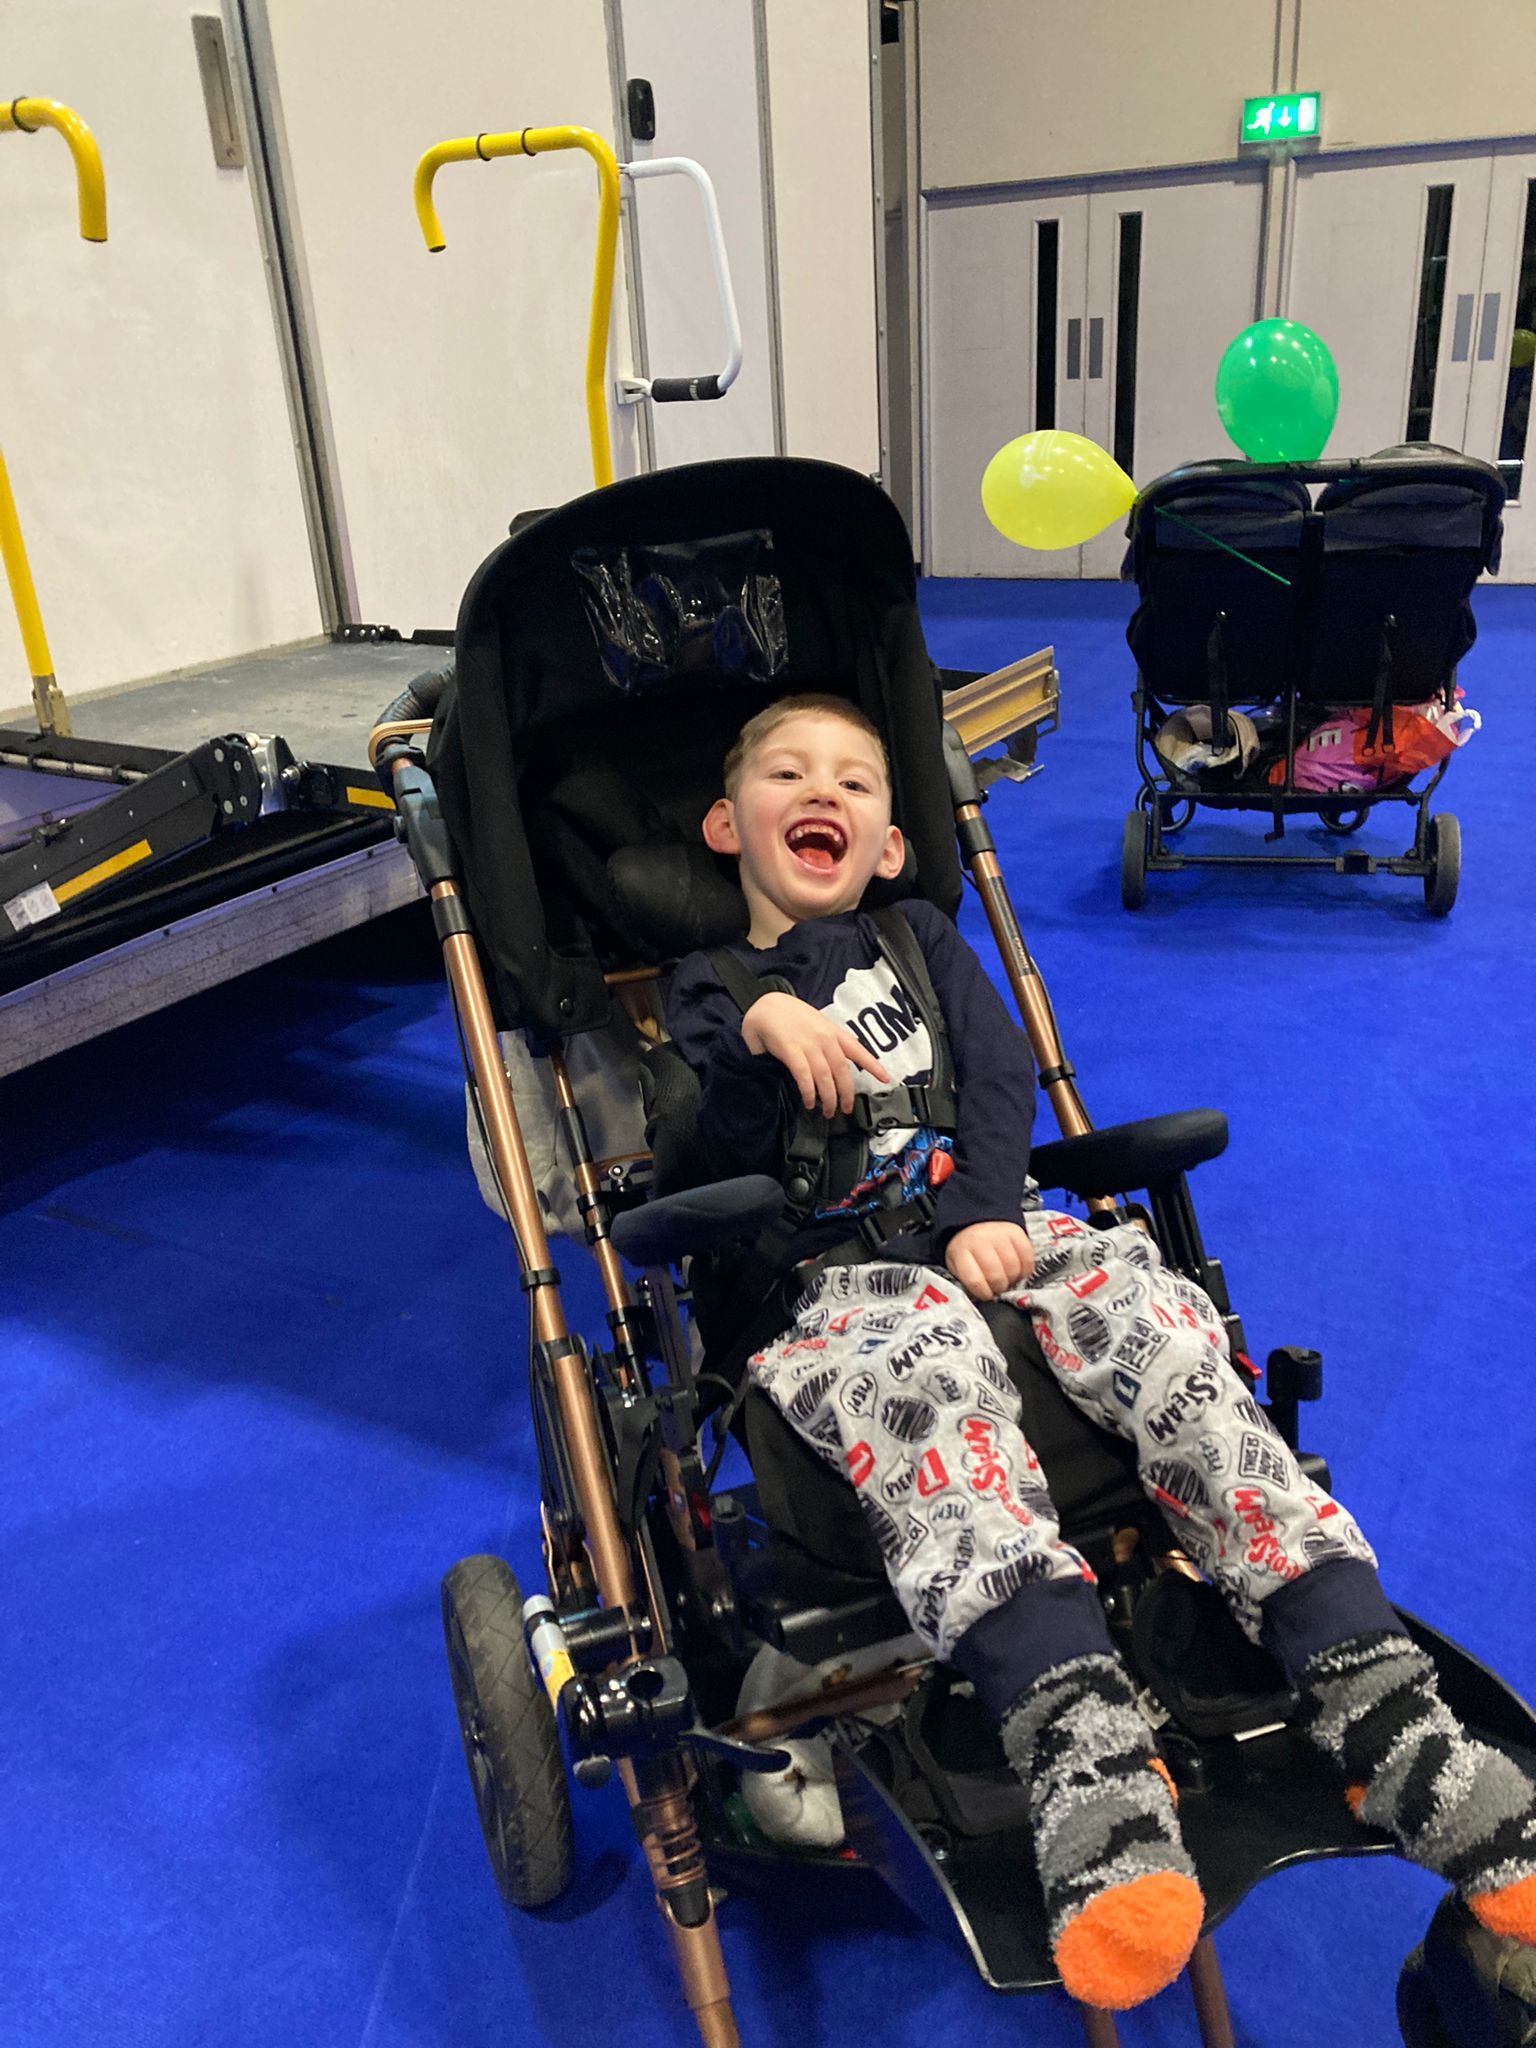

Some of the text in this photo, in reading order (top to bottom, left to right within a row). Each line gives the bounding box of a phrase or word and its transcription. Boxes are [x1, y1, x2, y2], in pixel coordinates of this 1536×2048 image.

[889, 1326, 962, 1376] STEAM
[847, 1376, 874, 1414] PEEP!
[1147, 1374, 1218, 1441] STEAM
